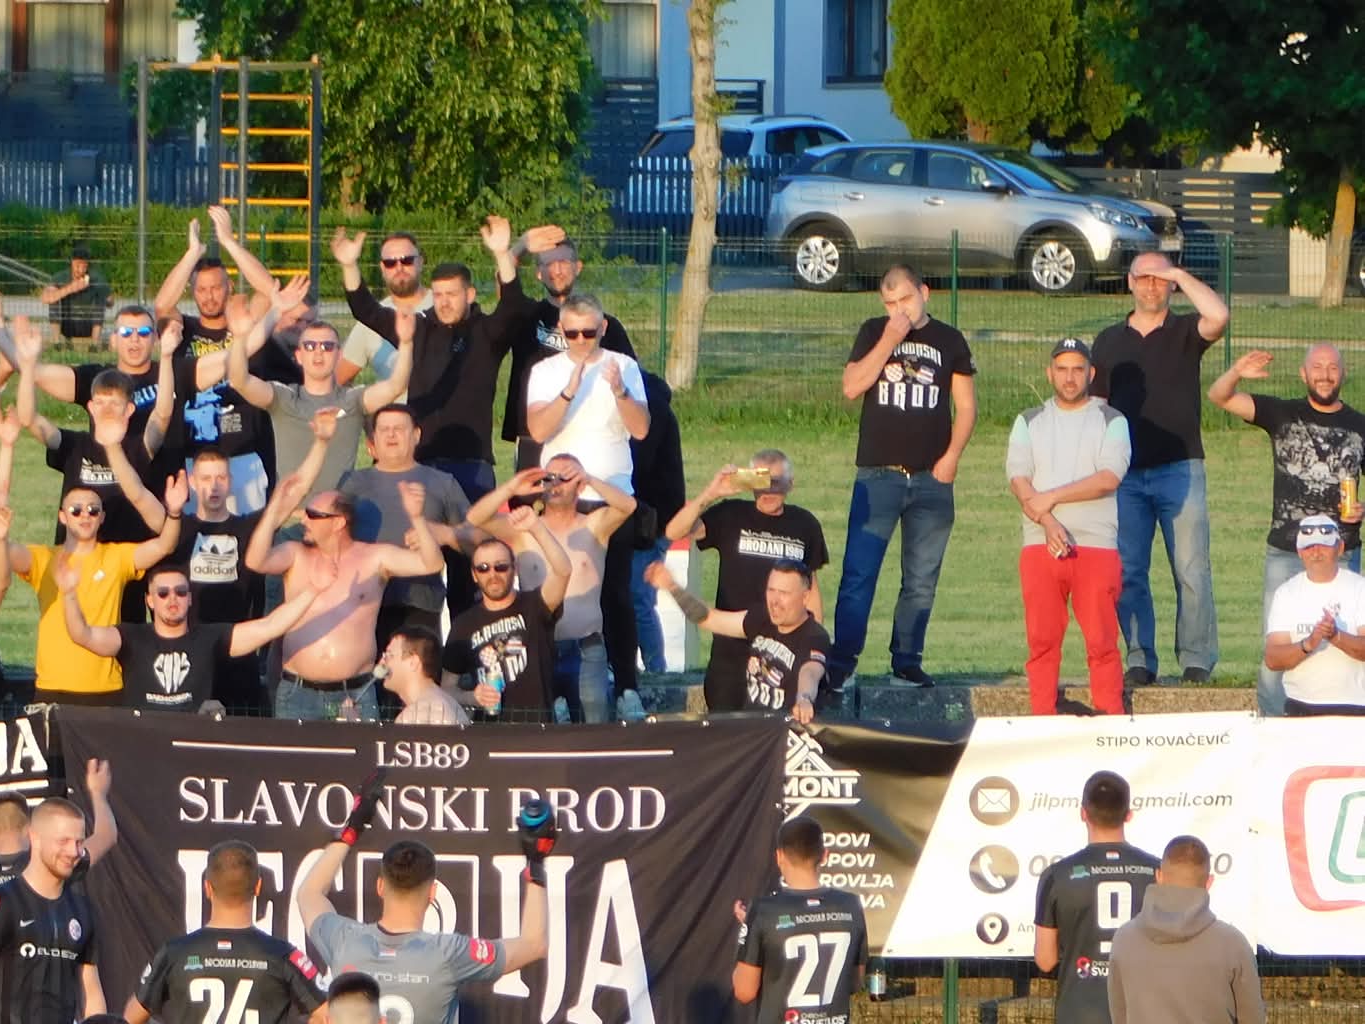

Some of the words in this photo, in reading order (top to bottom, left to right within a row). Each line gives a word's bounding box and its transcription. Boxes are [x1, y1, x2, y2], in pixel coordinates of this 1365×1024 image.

[878, 381, 939, 411] BROD
[376, 741, 471, 769] LSB89
[1095, 736, 1141, 747] STIPO
[1145, 730, 1231, 746] KOVAČEVIĆ
[178, 778, 489, 832] SLAVONSKI
[1097, 881, 1132, 954] 9
[785, 931, 851, 1008] 27
